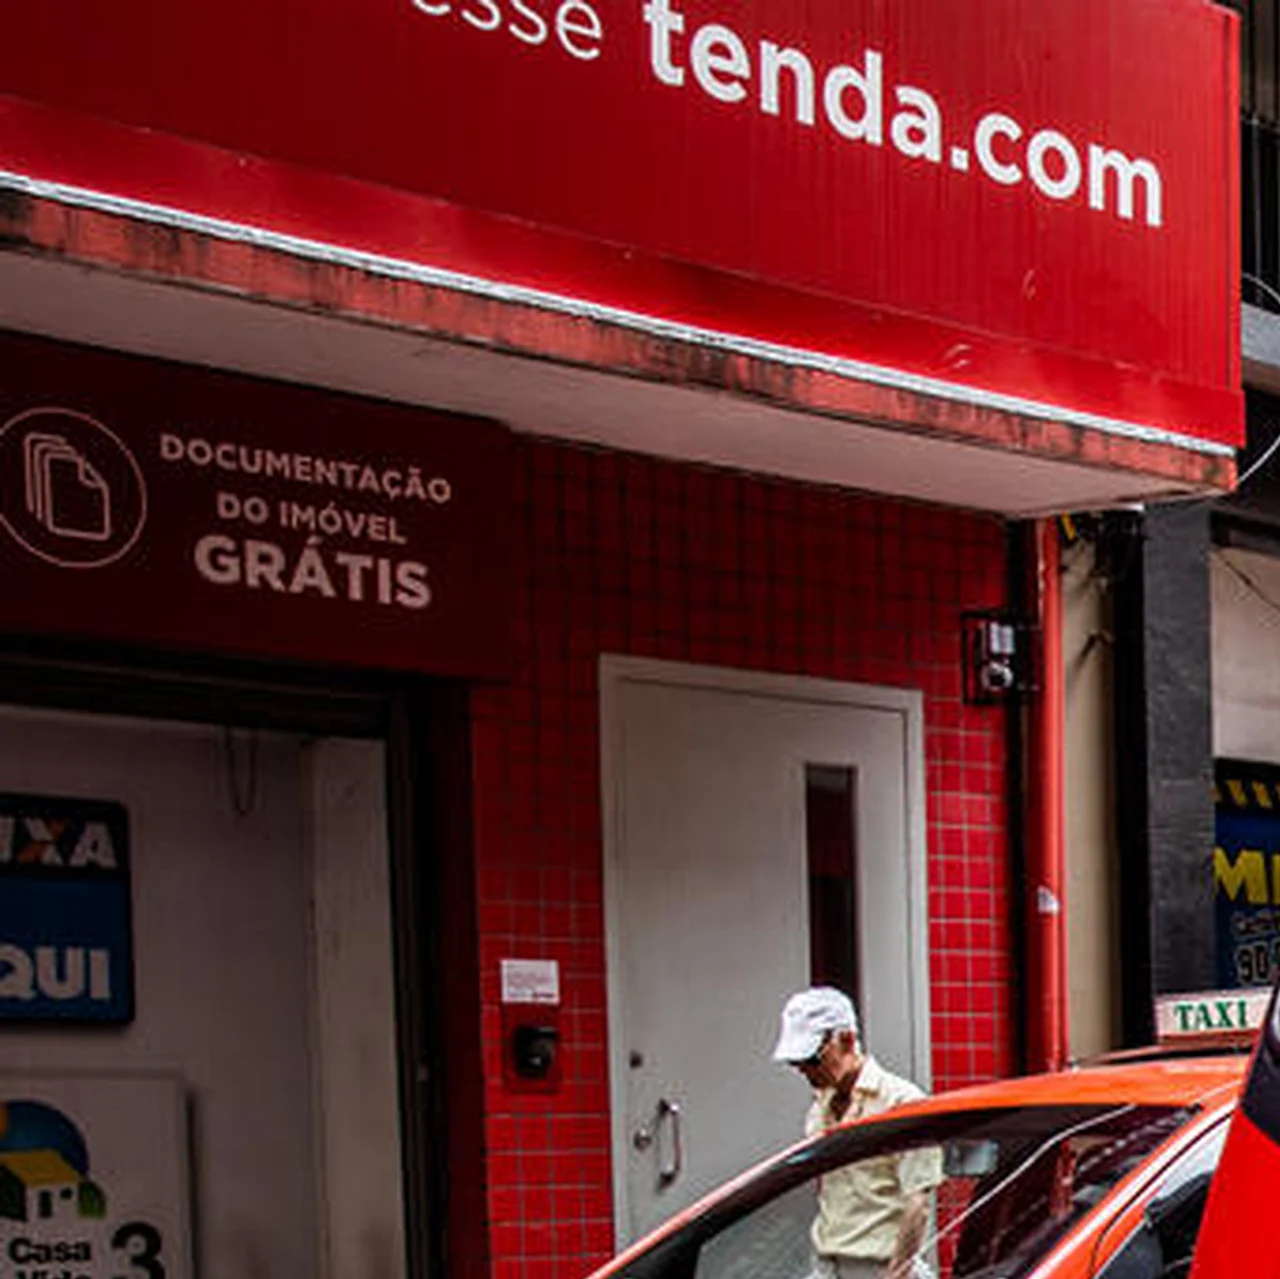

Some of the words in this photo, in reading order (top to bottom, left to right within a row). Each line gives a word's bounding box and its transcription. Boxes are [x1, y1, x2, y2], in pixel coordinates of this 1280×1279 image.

[643, 0, 1164, 228] tenda.com
[159, 432, 451, 504] DOCUMENTAÇÃO
[216, 491, 270, 525] DO
[278, 501, 408, 545] IMÓVEL
[193, 533, 432, 610] GRÁTIS
[1173, 1001, 1248, 1032] TAXI
[8, 1236, 92, 1265] Casa
